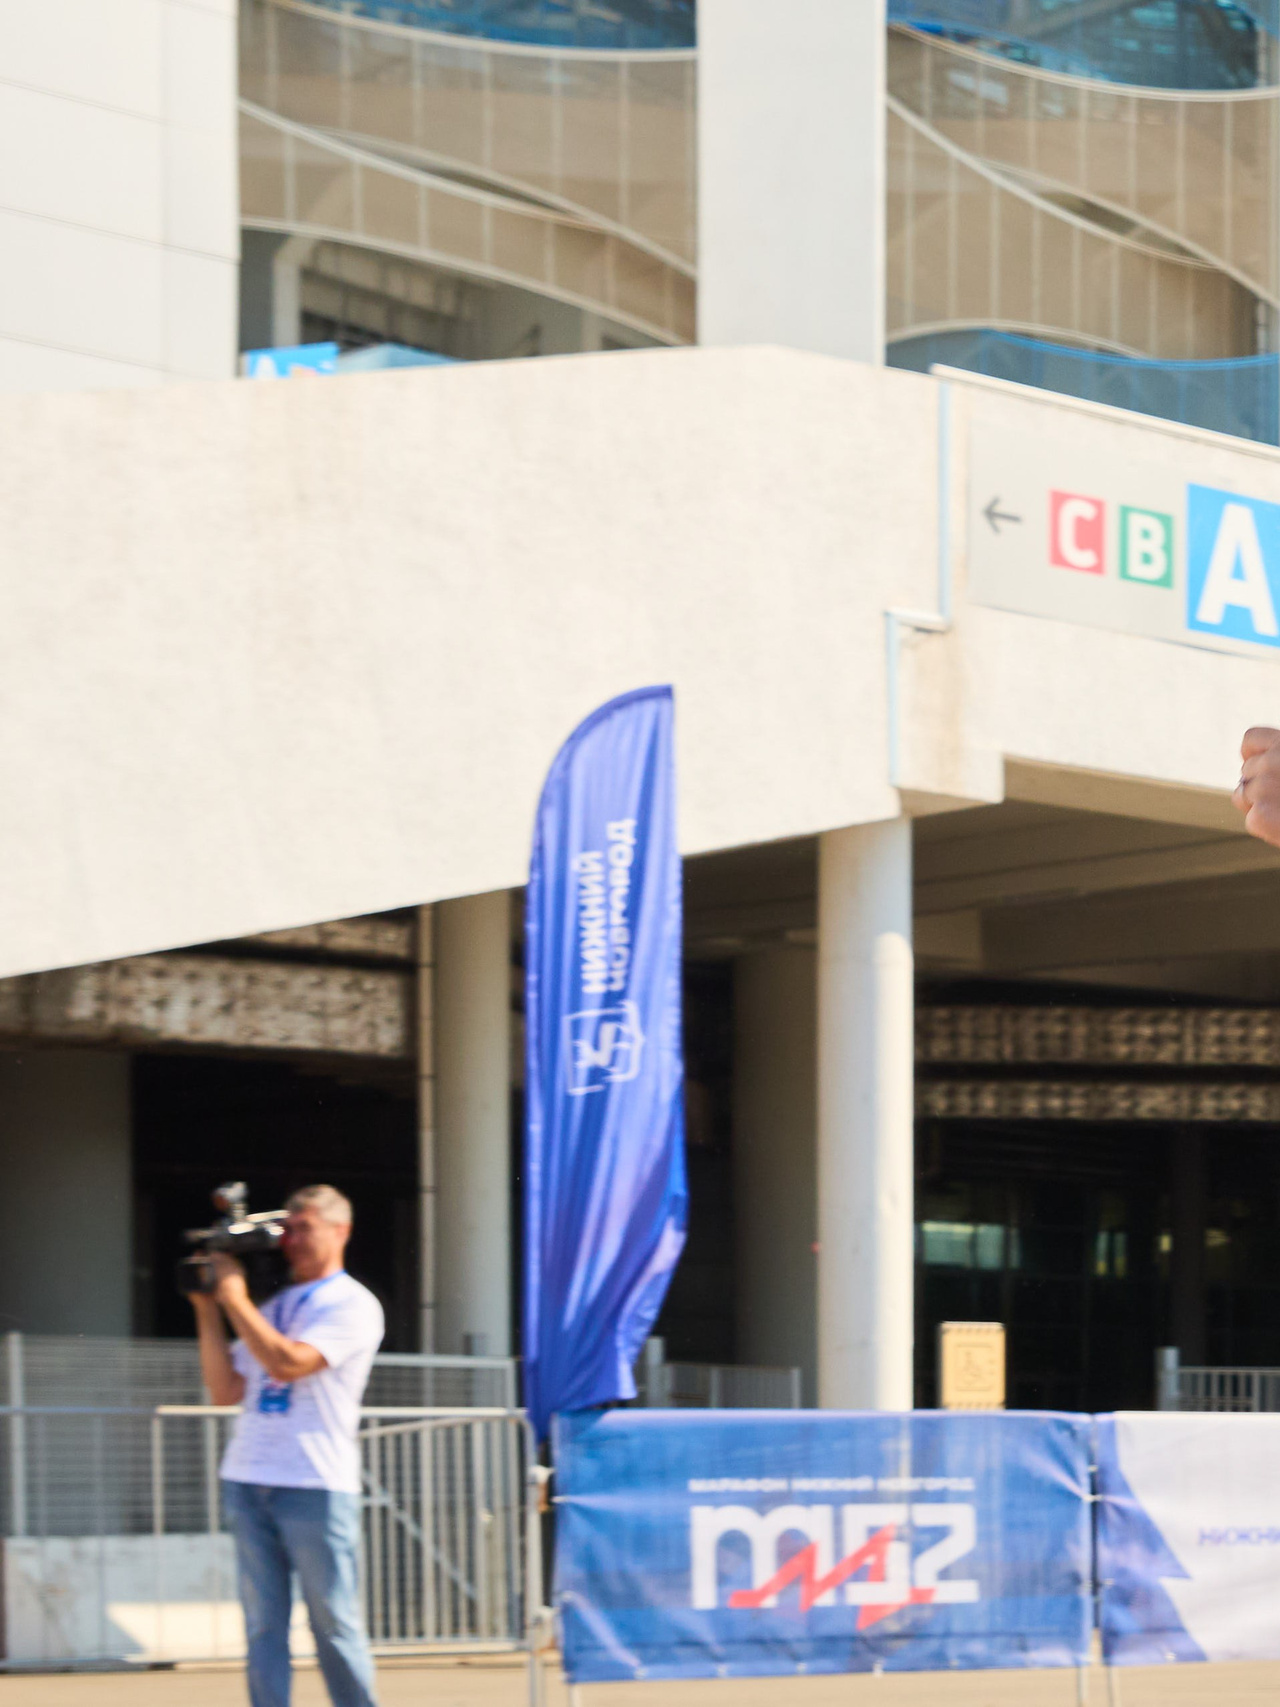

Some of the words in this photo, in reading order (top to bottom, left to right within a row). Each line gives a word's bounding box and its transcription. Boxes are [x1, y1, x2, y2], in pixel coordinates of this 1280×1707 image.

[1057, 498, 1099, 569] C
[1126, 512, 1168, 581] B
[1195, 502, 1279, 637] A
[572, 851, 606, 993] НИЖНИЙ
